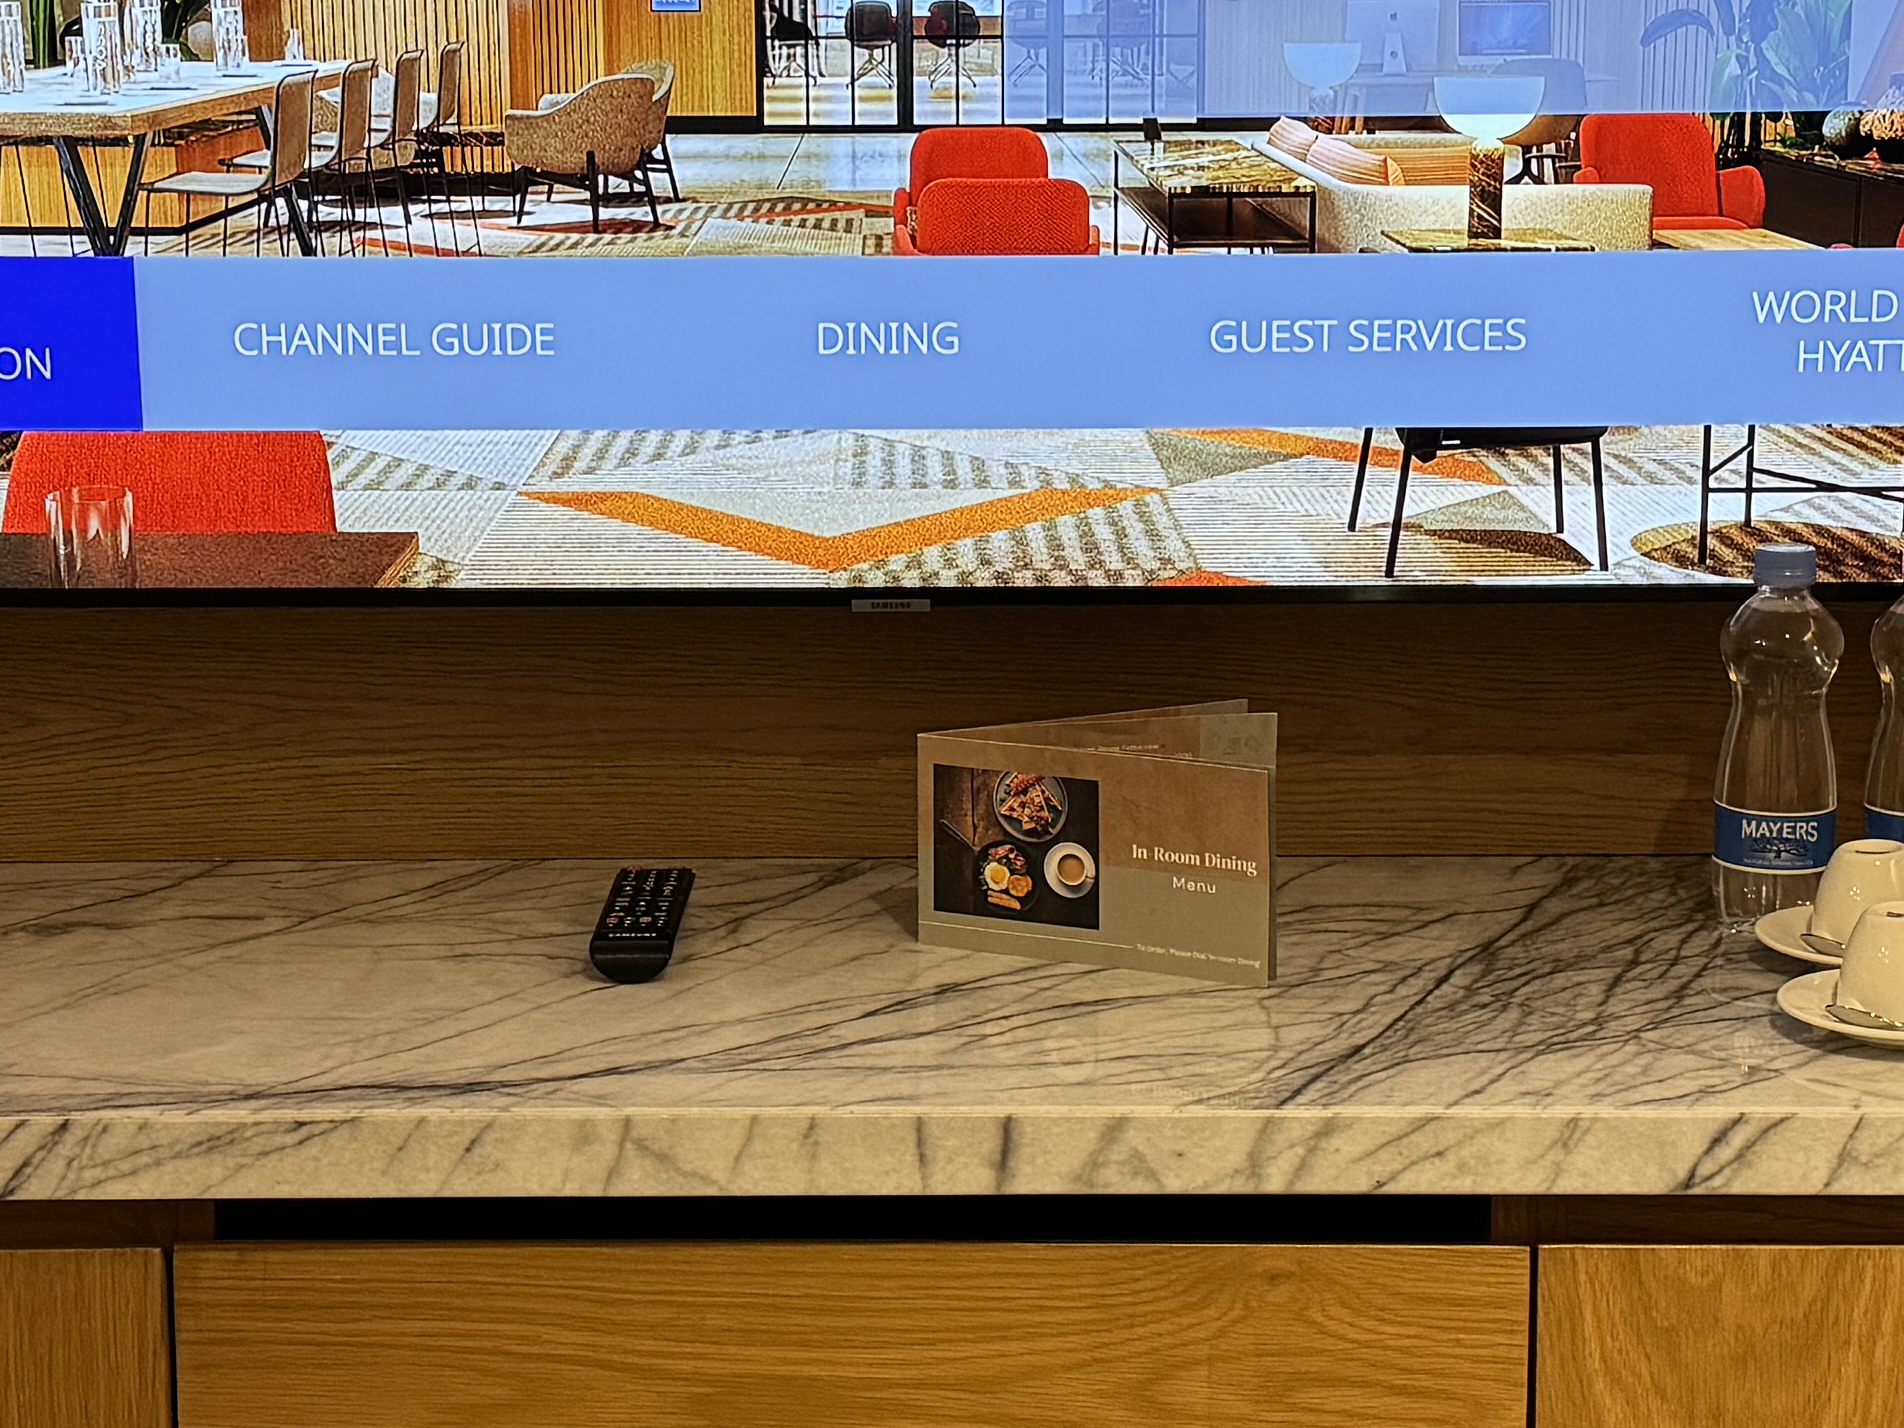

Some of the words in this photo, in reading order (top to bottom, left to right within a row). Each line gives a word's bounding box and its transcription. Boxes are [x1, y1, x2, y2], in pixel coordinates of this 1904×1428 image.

[1752, 289, 1899, 324] WORLD
[233, 322, 421, 356] CHANNEL
[431, 322, 555, 356] GUIDE
[817, 321, 960, 355] DINING
[1209, 319, 1338, 353] GUEST
[1347, 318, 1527, 352] SERVICES
[1741, 818, 1818, 843] MAYERS
[1204, 852, 1258, 877] Dining
[1172, 875, 1217, 894] Menu
